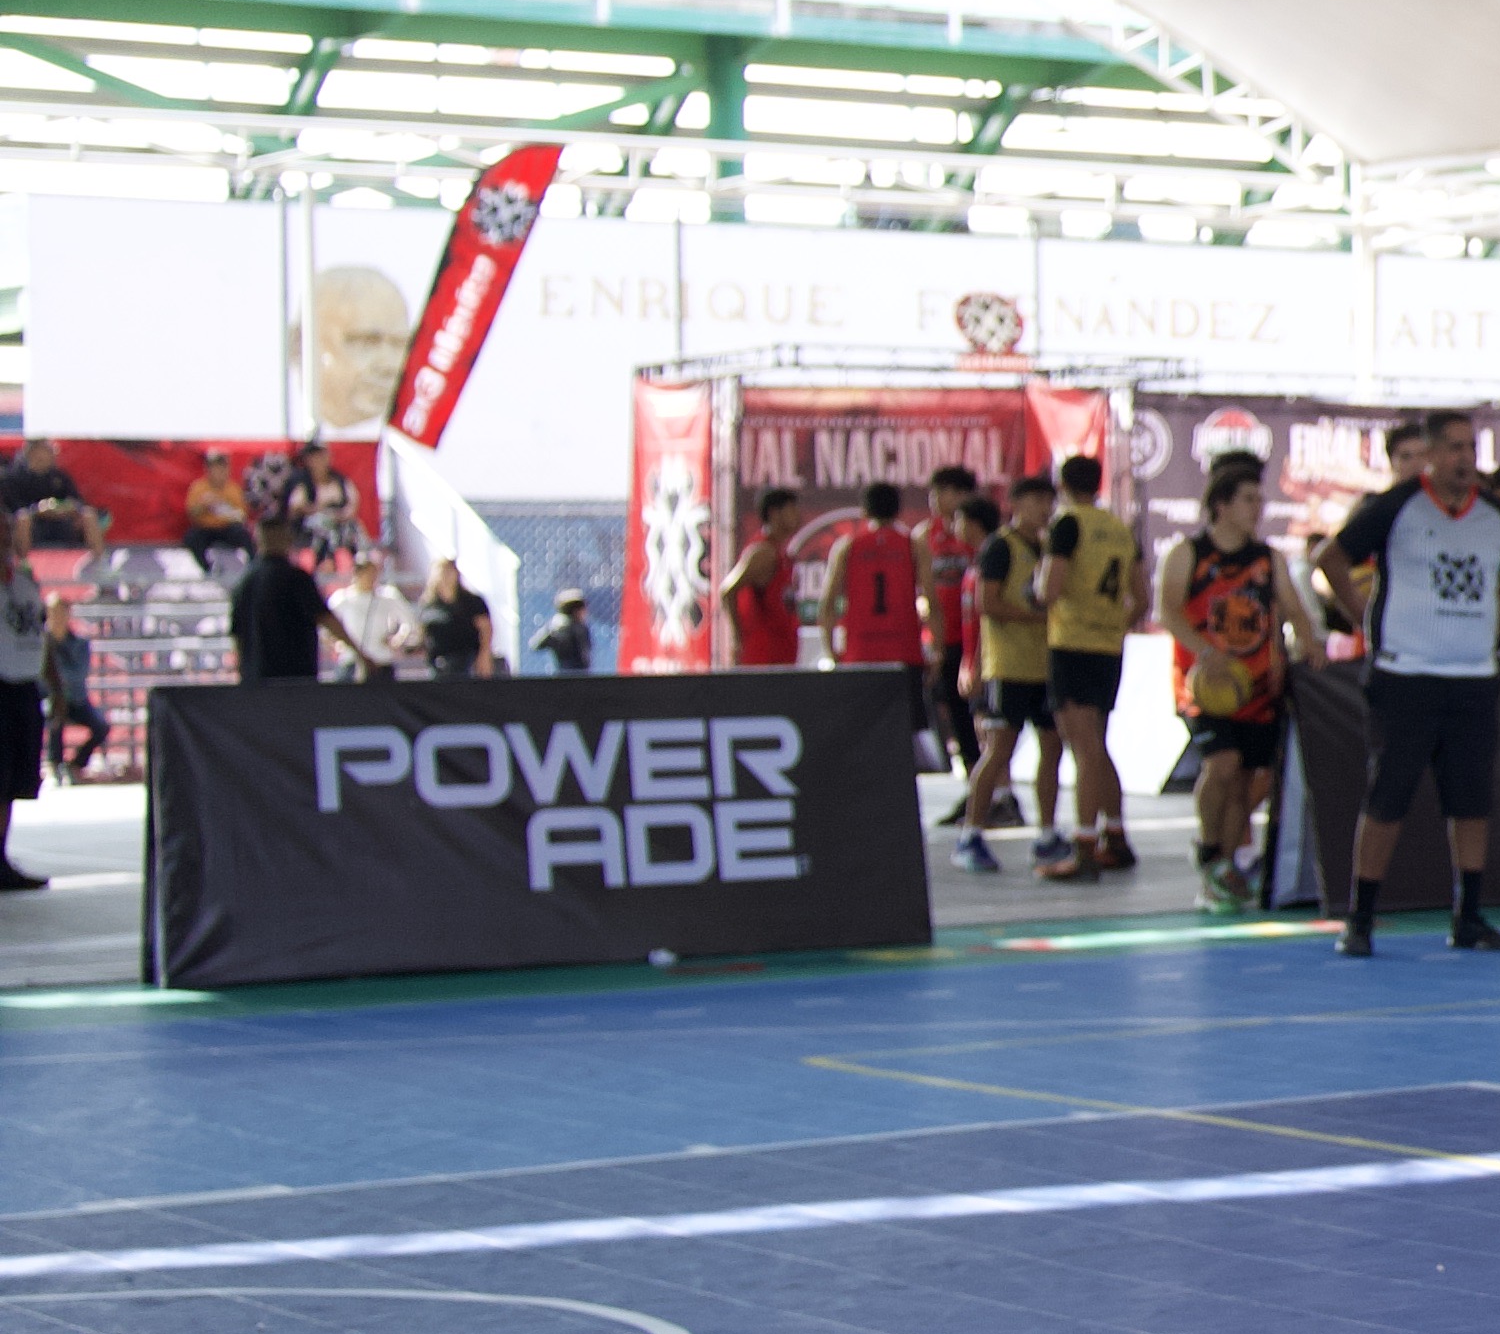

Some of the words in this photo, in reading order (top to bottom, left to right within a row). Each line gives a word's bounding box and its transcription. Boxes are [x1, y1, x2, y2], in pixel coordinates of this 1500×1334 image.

[540, 274, 847, 327] ENRIQUE
[916, 274, 1286, 344] FNÁNDEZ
[814, 427, 1012, 488] NACIONAL
[1096, 556, 1122, 603] 4
[313, 715, 802, 813] POWER
[526, 799, 802, 892] ADE
